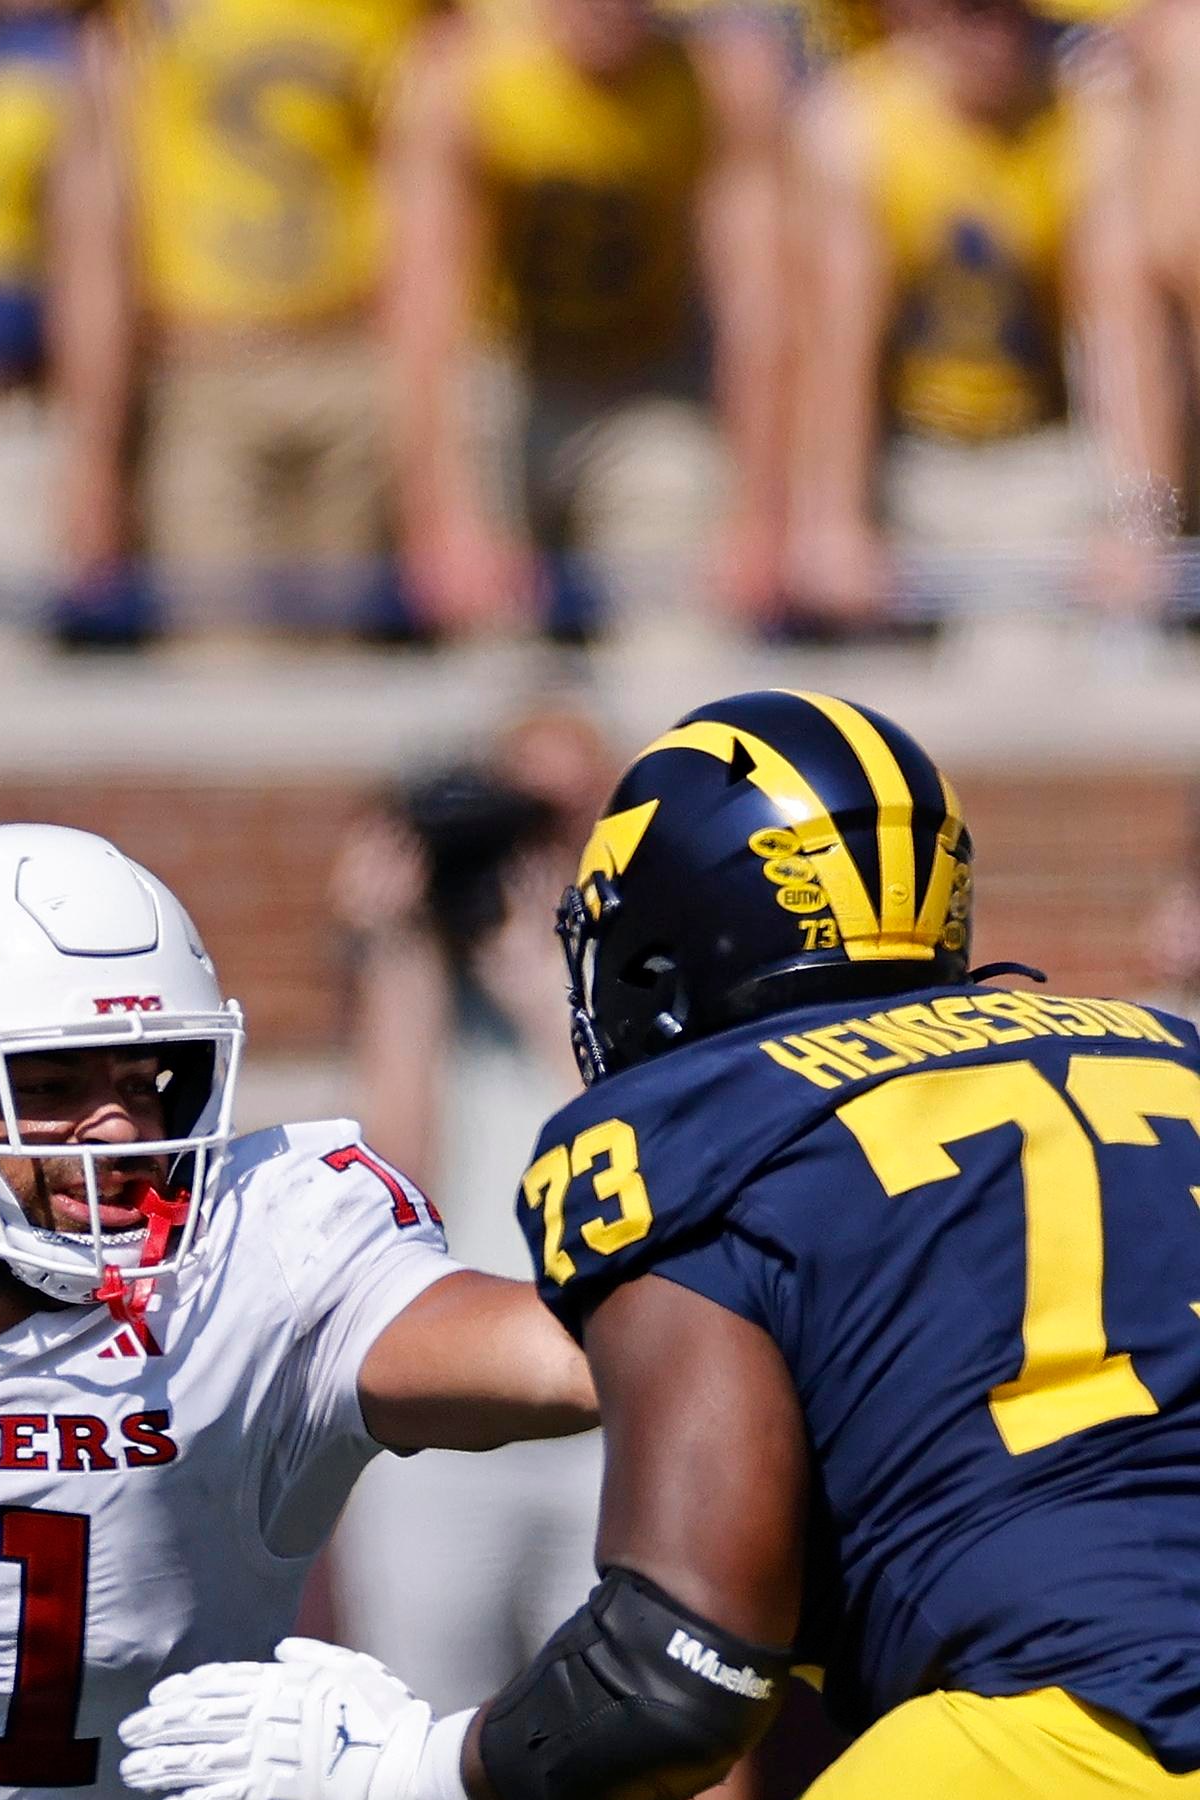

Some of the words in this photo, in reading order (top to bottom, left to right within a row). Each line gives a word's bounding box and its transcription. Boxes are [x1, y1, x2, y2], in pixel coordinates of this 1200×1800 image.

[798, 917, 839, 951] 73
[758, 990, 1186, 1090] HENDERSON
[522, 1117, 654, 1287] 73
